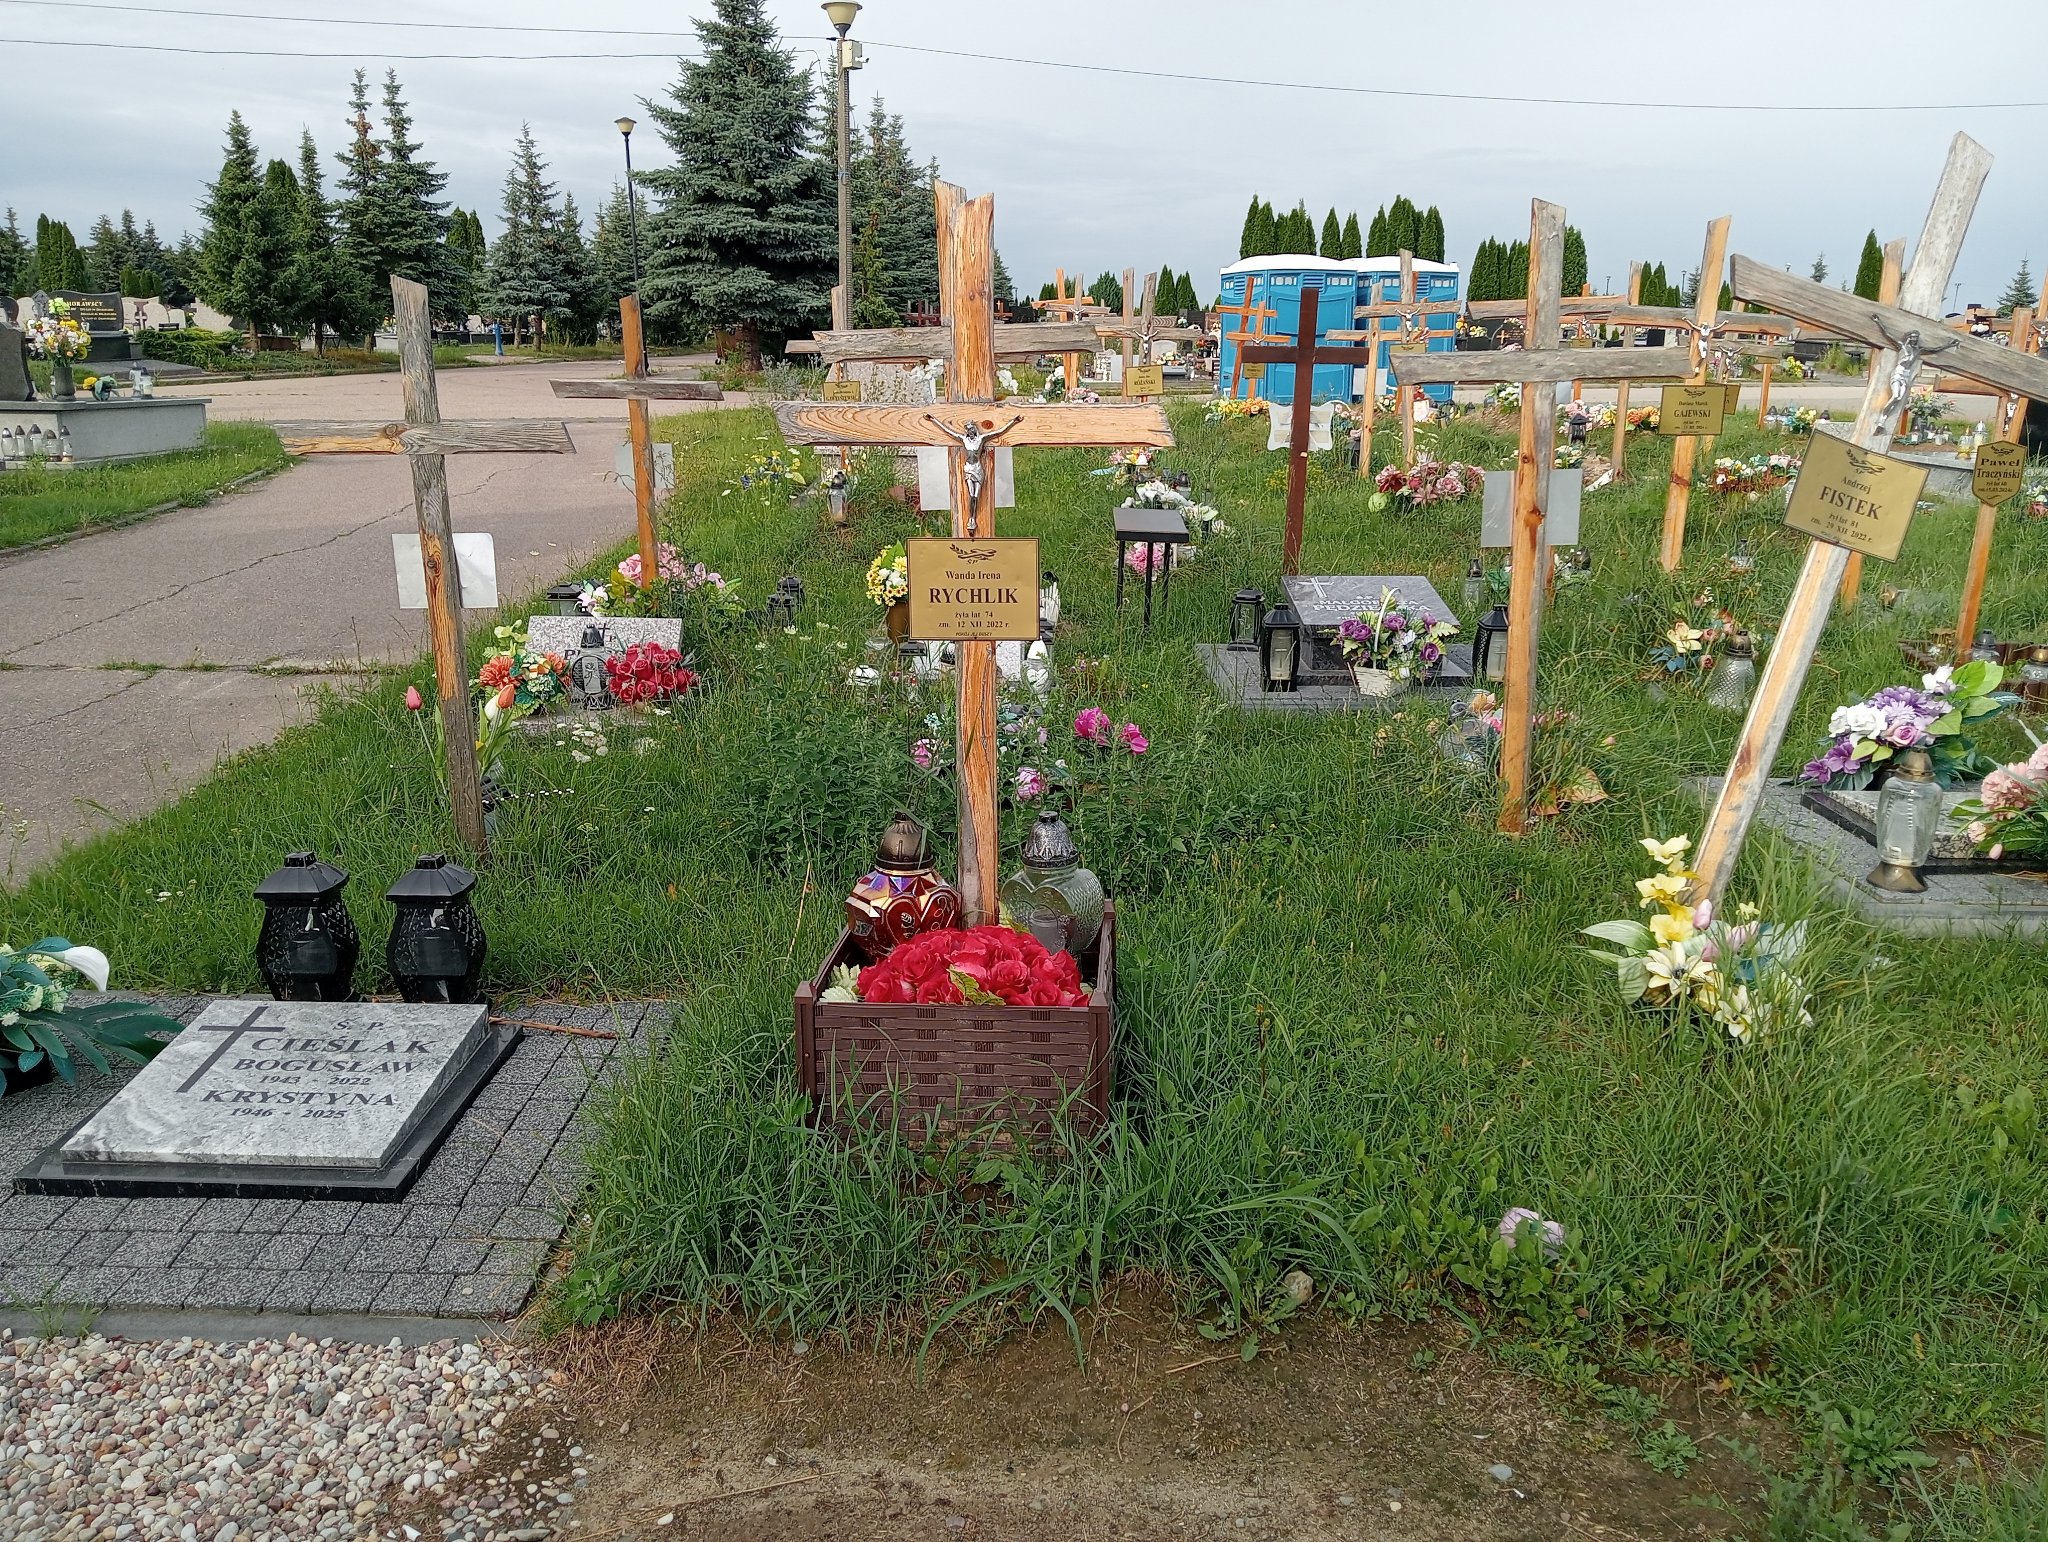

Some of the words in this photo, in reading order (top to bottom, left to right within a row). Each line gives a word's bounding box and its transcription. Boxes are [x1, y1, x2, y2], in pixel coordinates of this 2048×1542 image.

[1673, 409, 1711, 418] GAJEWSKI
[1976, 467, 2020, 480] Traczyński
[1841, 475, 1872, 495] Andrzej
[1819, 485, 1883, 520] FISTEK
[1850, 519, 1859, 528] 81
[1825, 521, 1835, 529] 29
[1836, 525, 1849, 535] XII
[1850, 530, 1868, 541] 2022
[945, 570, 976, 580] Wanda
[978, 570, 1001, 580] Irena
[928, 587, 1018, 604] RYCHLIK
[971, 610, 981, 618] lat
[984, 610, 994, 618] 74
[251, 1035, 437, 1053] CIEŚLAK
[232, 1058, 422, 1073] BOGUSŁAW
[258, 1075, 301, 1084] 1943
[200, 1090, 395, 1105] KRYSTYNA
[230, 1107, 276, 1117] 1946
[301, 1109, 348, 1119] 2025
